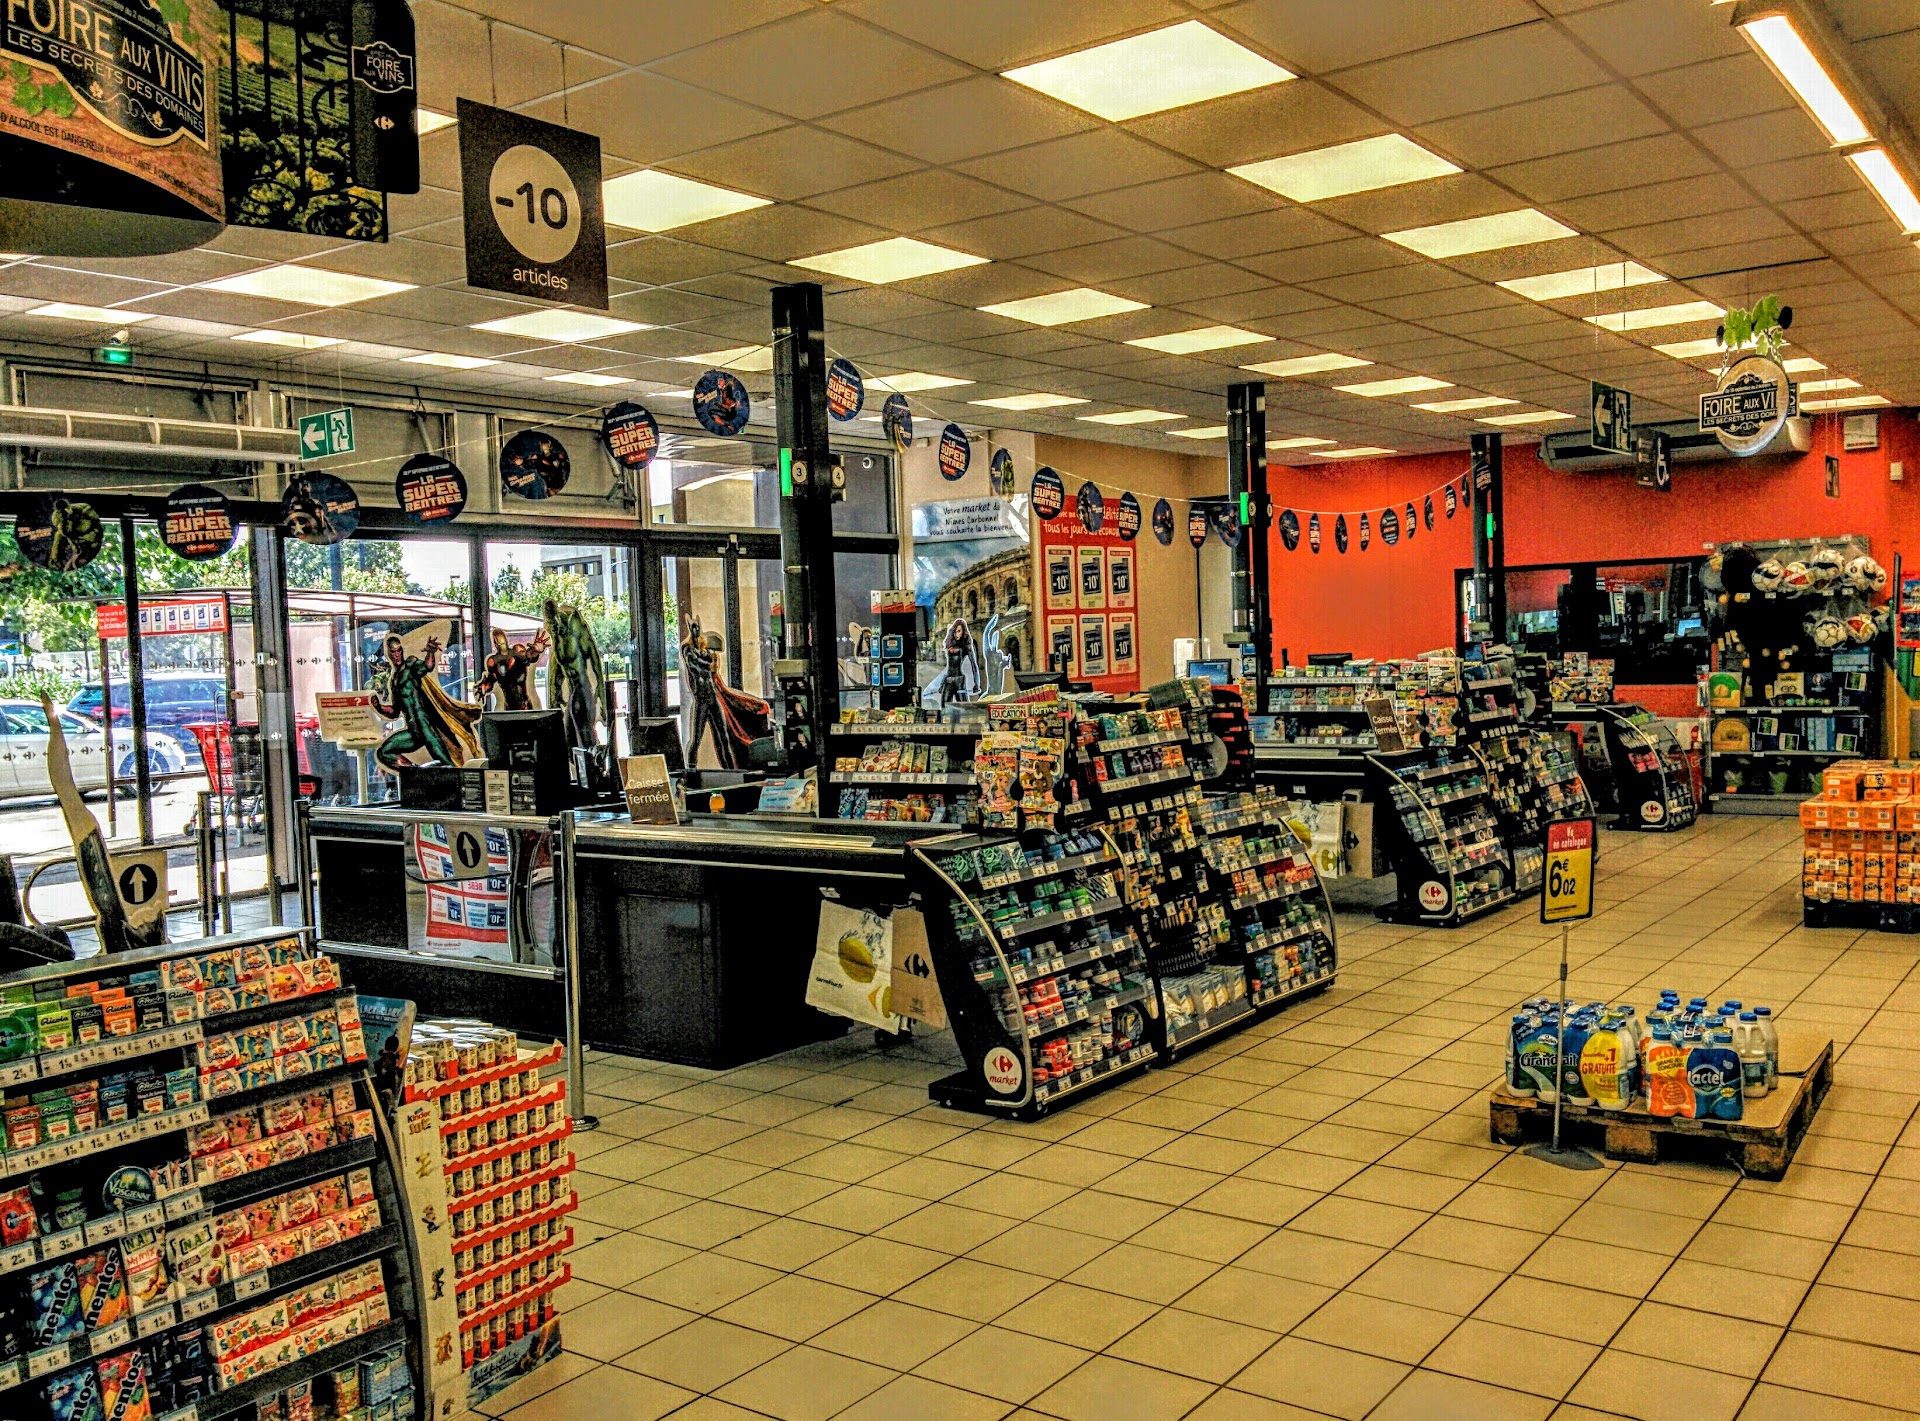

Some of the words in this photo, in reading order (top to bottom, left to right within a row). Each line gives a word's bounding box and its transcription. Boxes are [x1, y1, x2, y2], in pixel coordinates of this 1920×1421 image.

[366, 57, 401, 72] FOIRE
[7, 29, 44, 53] LES
[48, 44, 124, 85] SECRETS
[127, 74, 153, 100] DES
[155, 92, 205, 134] DOMAINES
[121, 36, 153, 74] AUX
[154, 44, 204, 114] VINS
[377, 69, 405, 83] VINS
[44, 125, 59, 138] EST
[495, 182, 568, 230] -10
[512, 264, 569, 291] articles
[828, 377, 858, 404] SUPER
[1703, 395, 1742, 417] FOIRE
[1743, 398, 1760, 410] AUX
[1715, 415, 1745, 424] SECRETS
[1746, 412, 1760, 420] DES
[622, 421, 636, 431] LA
[610, 427, 655, 448] SUPER
[612, 438, 657, 457] RENTREE
[941, 445, 966, 464] SUPER
[796, 467, 802, 477] 3
[420, 475, 435, 485] LA
[403, 481, 461, 502] SUPER
[1034, 488, 1061, 503] SUPER
[405, 493, 463, 512] RENTREE
[943, 506, 960, 516] Votre
[961, 502, 991, 513] market
[1033, 496, 1061, 509] RENTREE
[188, 507, 204, 517] LA
[166, 516, 231, 533] SUPER
[966, 514, 999, 524] Carbonnel
[946, 525, 974, 535] souhaite
[975, 524, 982, 532] la
[1043, 520, 1060, 534] tous
[1061, 523, 1070, 534] les
[1070, 522, 1088, 538] jours
[167, 530, 233, 544] RENTREE
[992, 709, 1027, 718] EDUCATION
[1031, 703, 1058, 716] forme
[1372, 714, 1394, 724] Caisse
[628, 777, 664, 789] Caisse
[629, 791, 670, 805] fermée
[1561, 836, 1587, 849] catalogue
[136, 995, 166, 1007] Ricola
[168, 990, 194, 1000] Ricola
[105, 1003, 132, 1014] Ricola
[40, 1015, 69, 1026] Ricola
[1656, 1058, 1673, 1066] GRAND
[1657, 1062, 1685, 1071] CONCOURS
[1582, 1063, 1616, 1075] GRATUITE
[168, 1073, 195, 1083] Ricola
[988, 1074, 1018, 1086] market
[1687, 1070, 1726, 1087] lactel
[407, 1111, 431, 1123] Kinder
[226, 1319, 250, 1336] Kinder
[304, 1328, 326, 1343] Kinder
[233, 1355, 256, 1372] Kinder
[106, 1351, 143, 1421] entos
